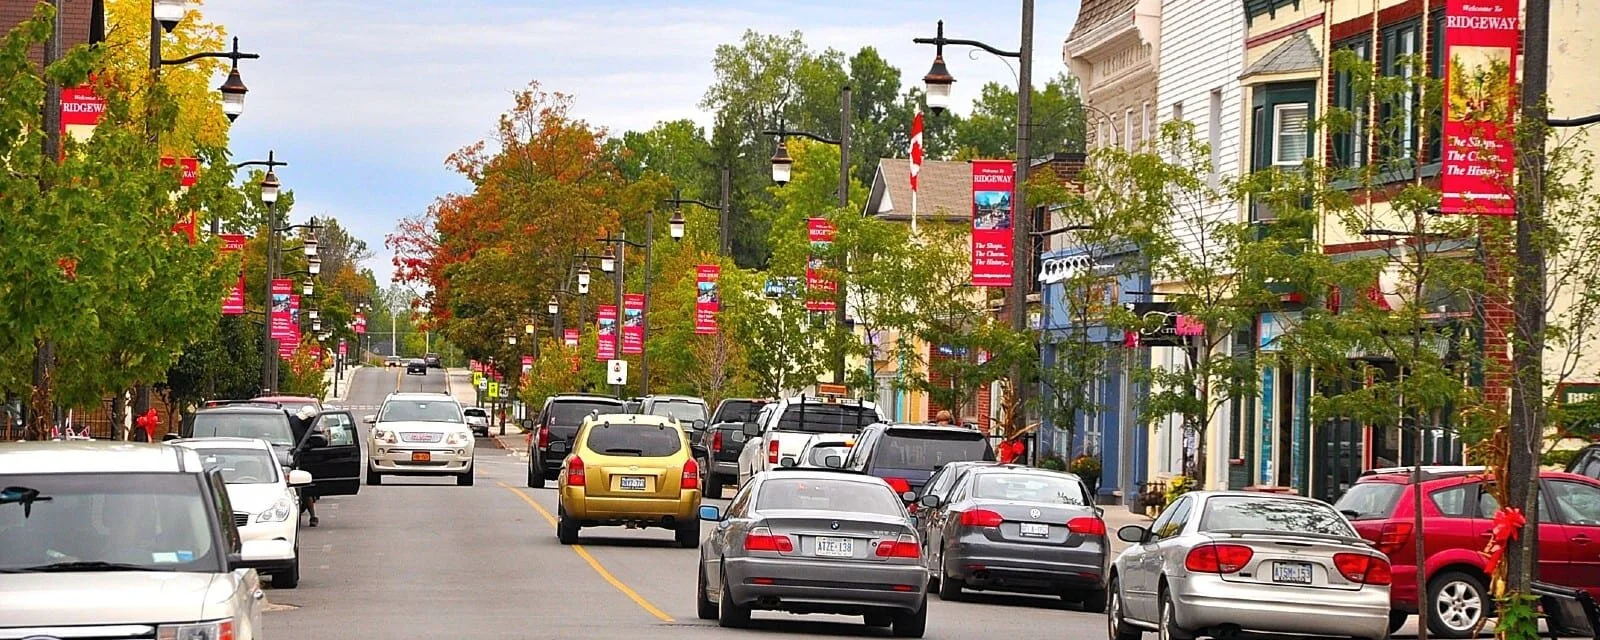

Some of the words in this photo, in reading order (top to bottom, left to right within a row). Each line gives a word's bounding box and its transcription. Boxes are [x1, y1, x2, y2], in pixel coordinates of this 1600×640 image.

[1446, 15, 1517, 30] RIDGEWAY
[63, 102, 106, 113] RIDGEWA
[1447, 150, 1466, 161] The
[1447, 165, 1466, 176] The
[974, 174, 1012, 183] RIDGEWAY
